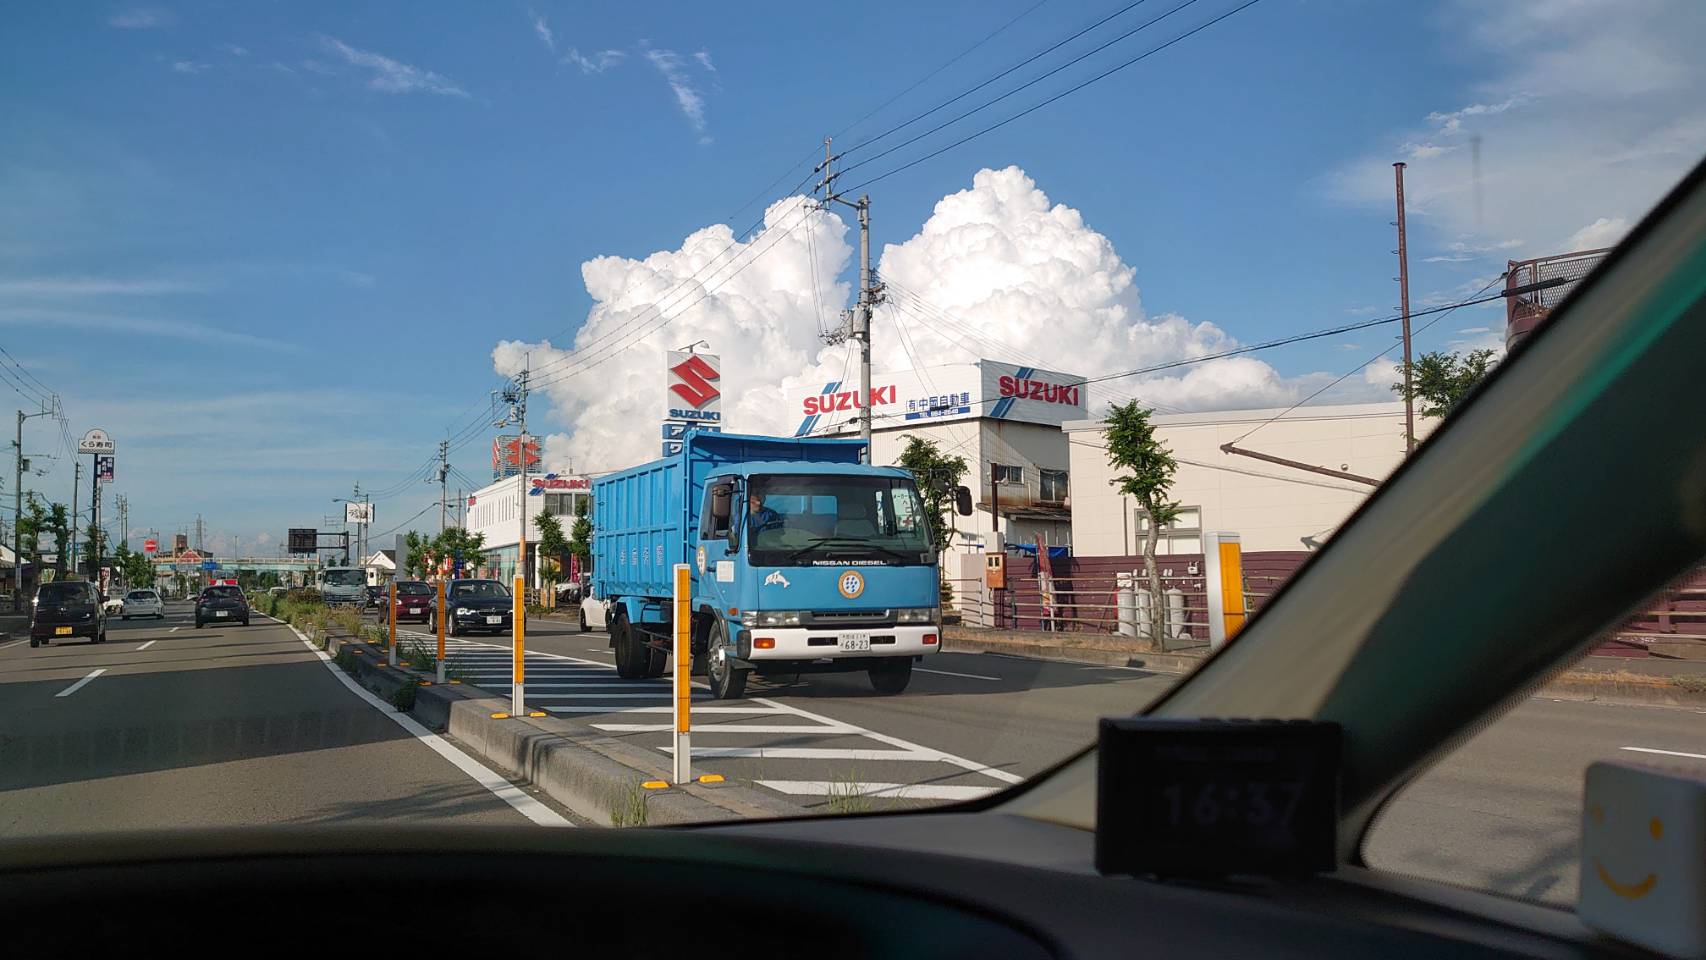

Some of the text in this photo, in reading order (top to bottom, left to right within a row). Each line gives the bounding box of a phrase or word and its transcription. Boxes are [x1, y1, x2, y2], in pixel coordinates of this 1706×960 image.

[803, 385, 896, 415] SUZUKI
[999, 376, 1078, 406] SUZUKI
[669, 408, 720, 420] SUZUKI
[532, 479, 590, 489] SUZUKI
[1163, 782, 1305, 826] 16:37
